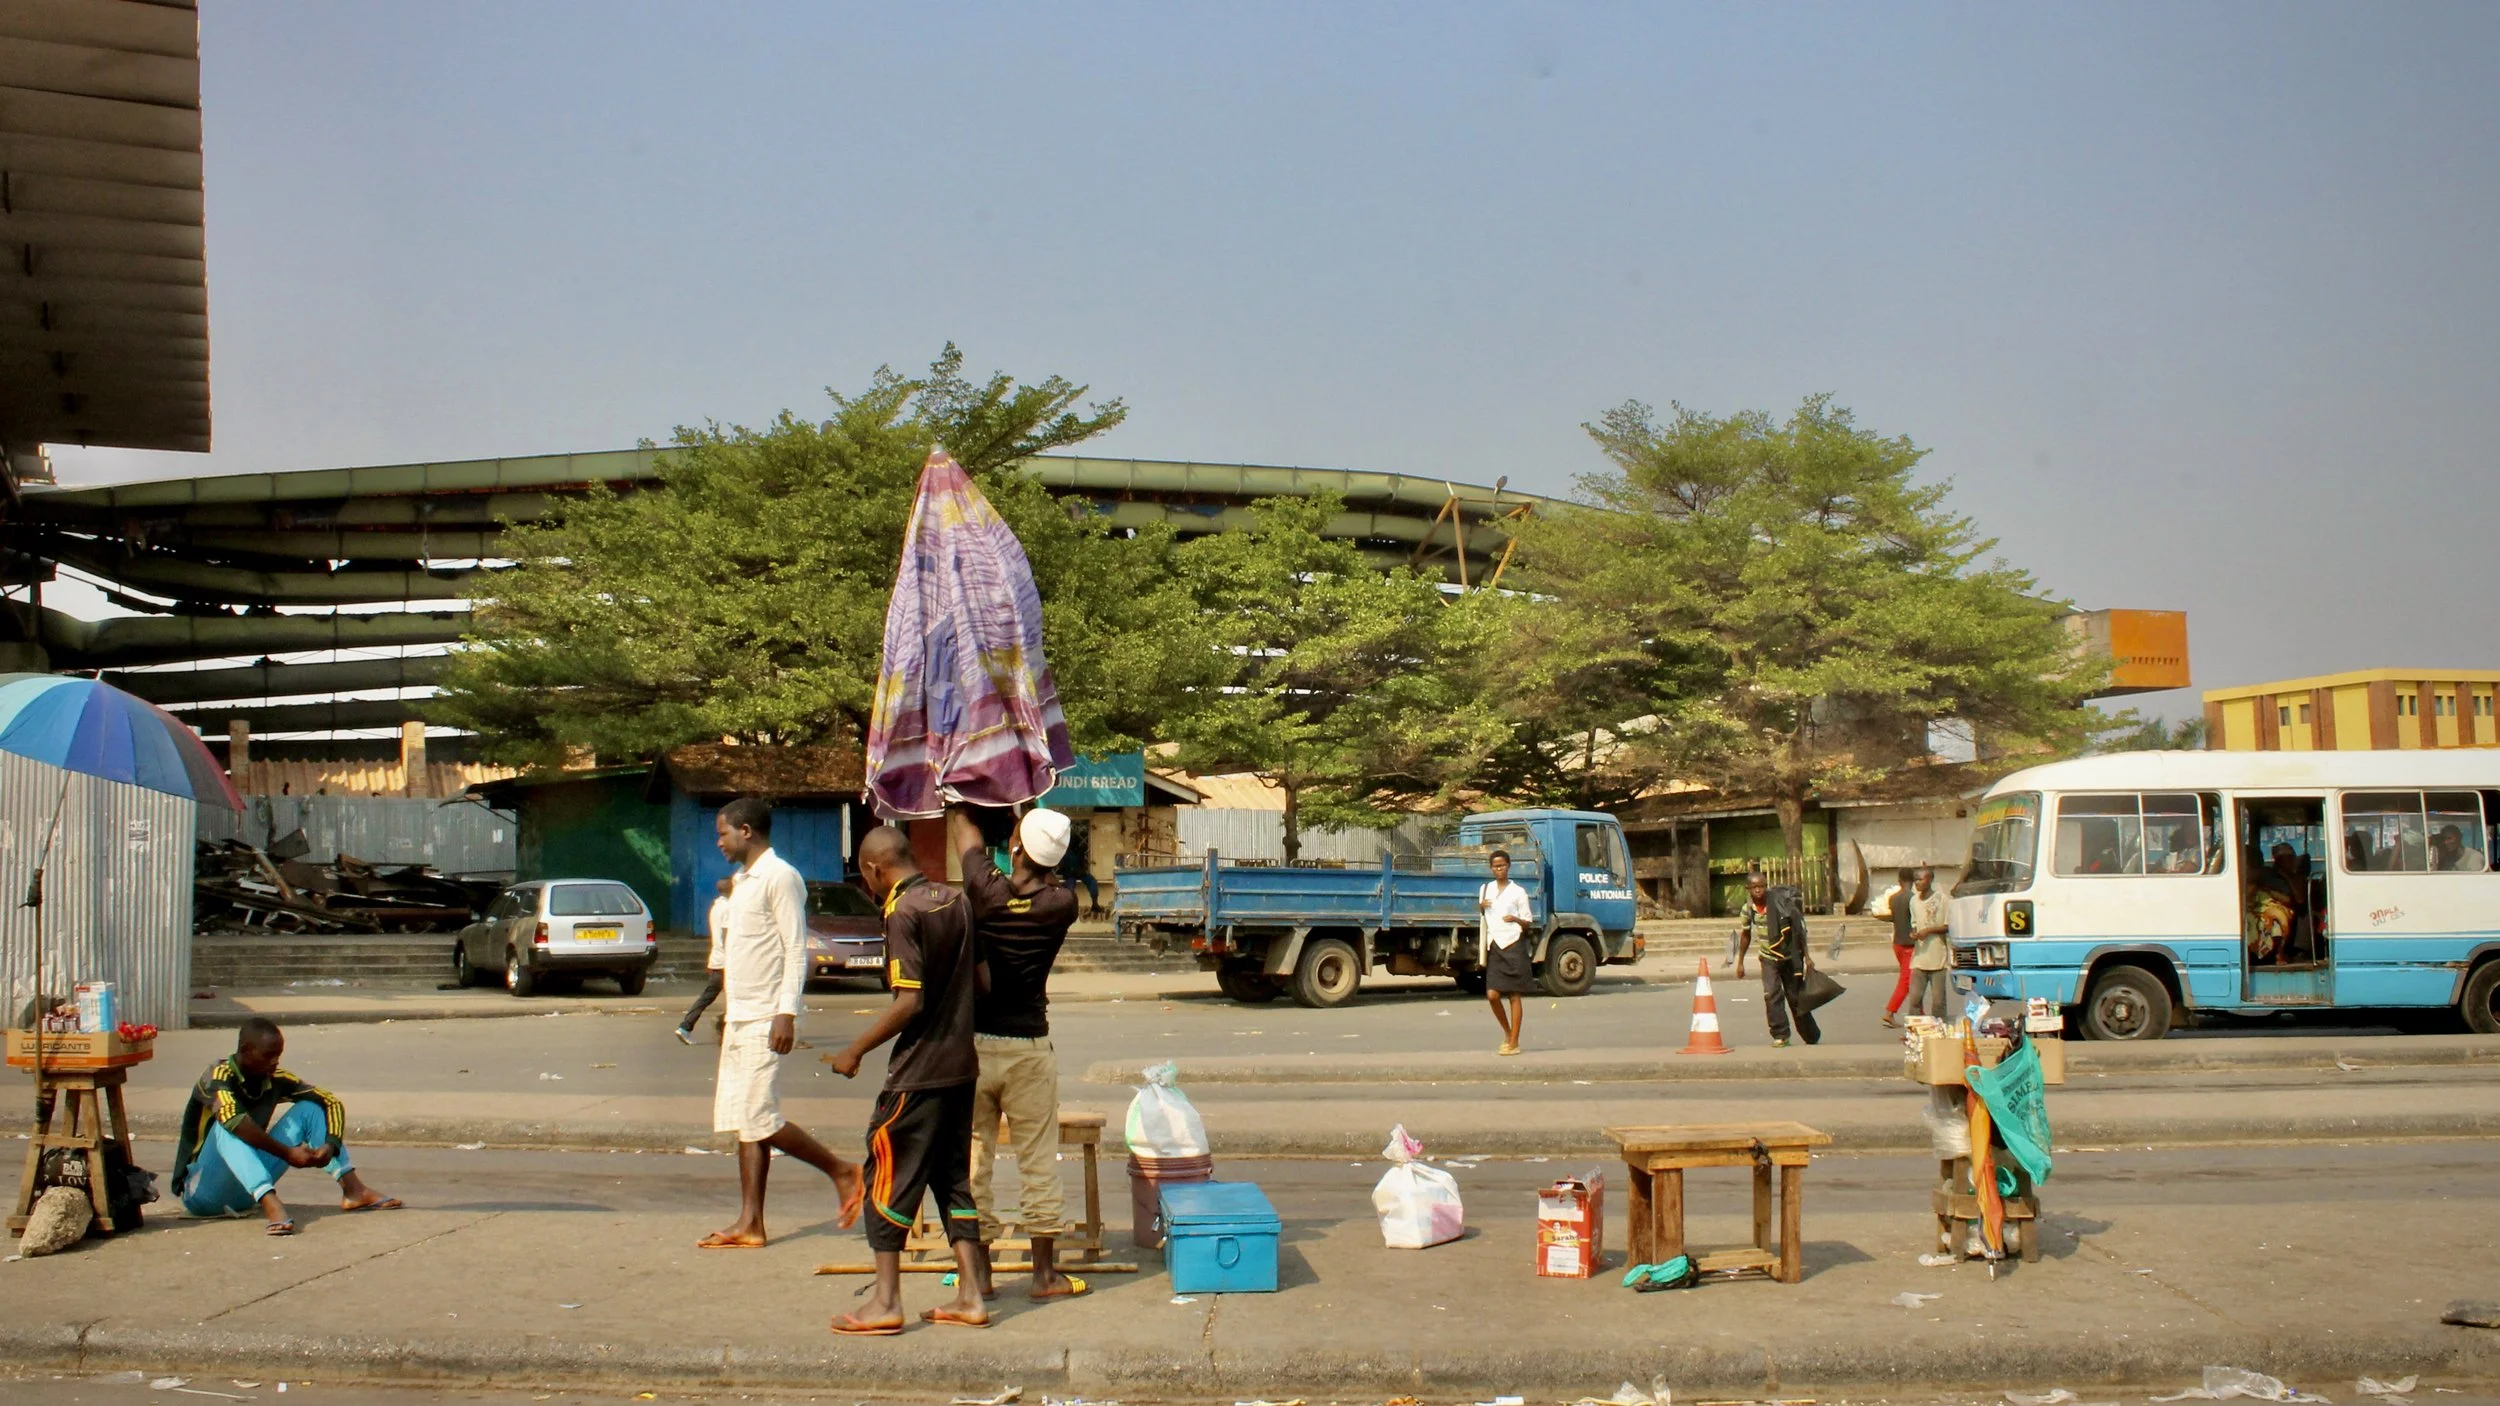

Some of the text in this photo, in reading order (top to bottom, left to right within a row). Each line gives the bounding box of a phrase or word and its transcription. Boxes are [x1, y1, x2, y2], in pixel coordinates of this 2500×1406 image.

[1091, 776, 1137, 789] BREAD
[1579, 873, 1608, 883] POLICE
[1590, 890, 1632, 899] NATIONALE
[2009, 910, 2026, 931] S
